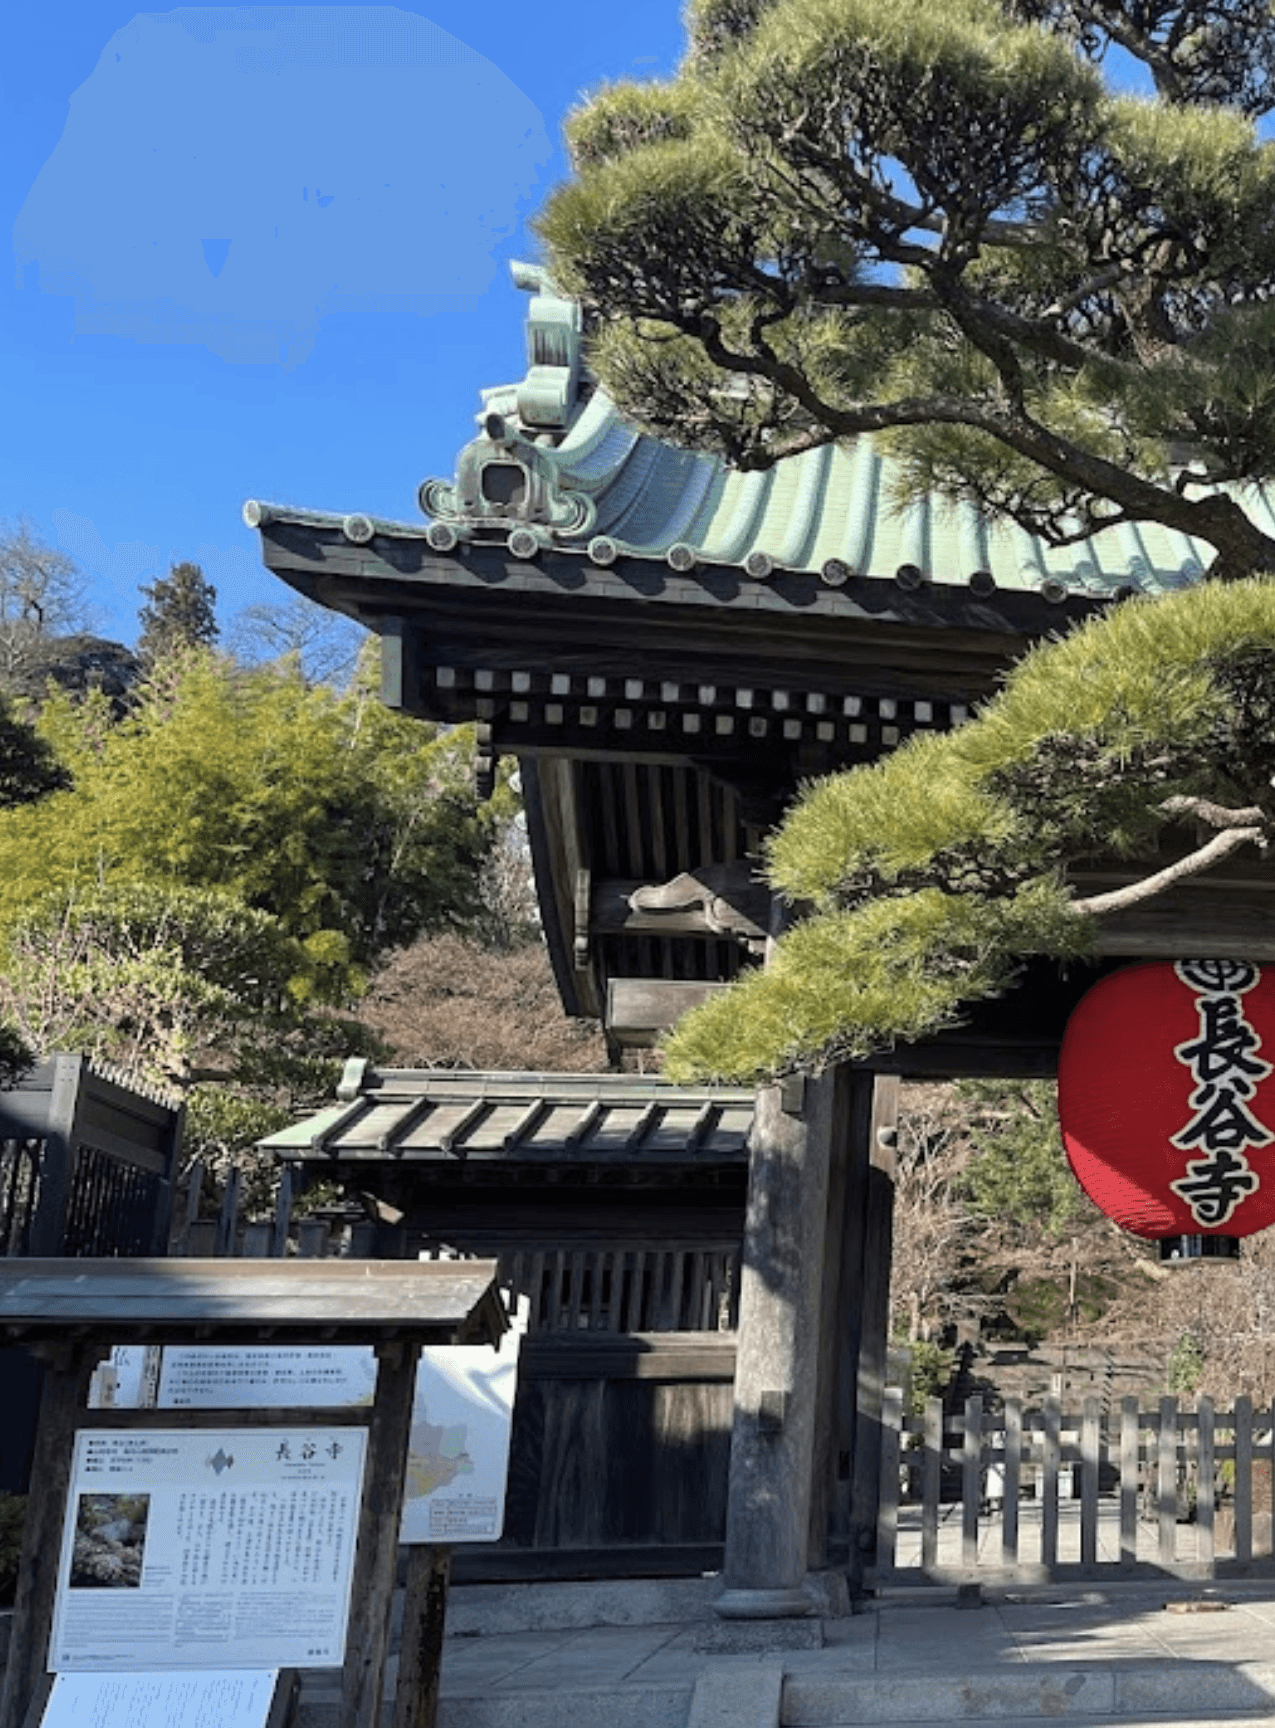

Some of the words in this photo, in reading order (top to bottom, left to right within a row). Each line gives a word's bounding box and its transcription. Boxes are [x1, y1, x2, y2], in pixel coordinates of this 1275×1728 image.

[1172, 996, 1274, 1226] 長谷寺
[276, 1440, 343, 1461] 長谷寺
